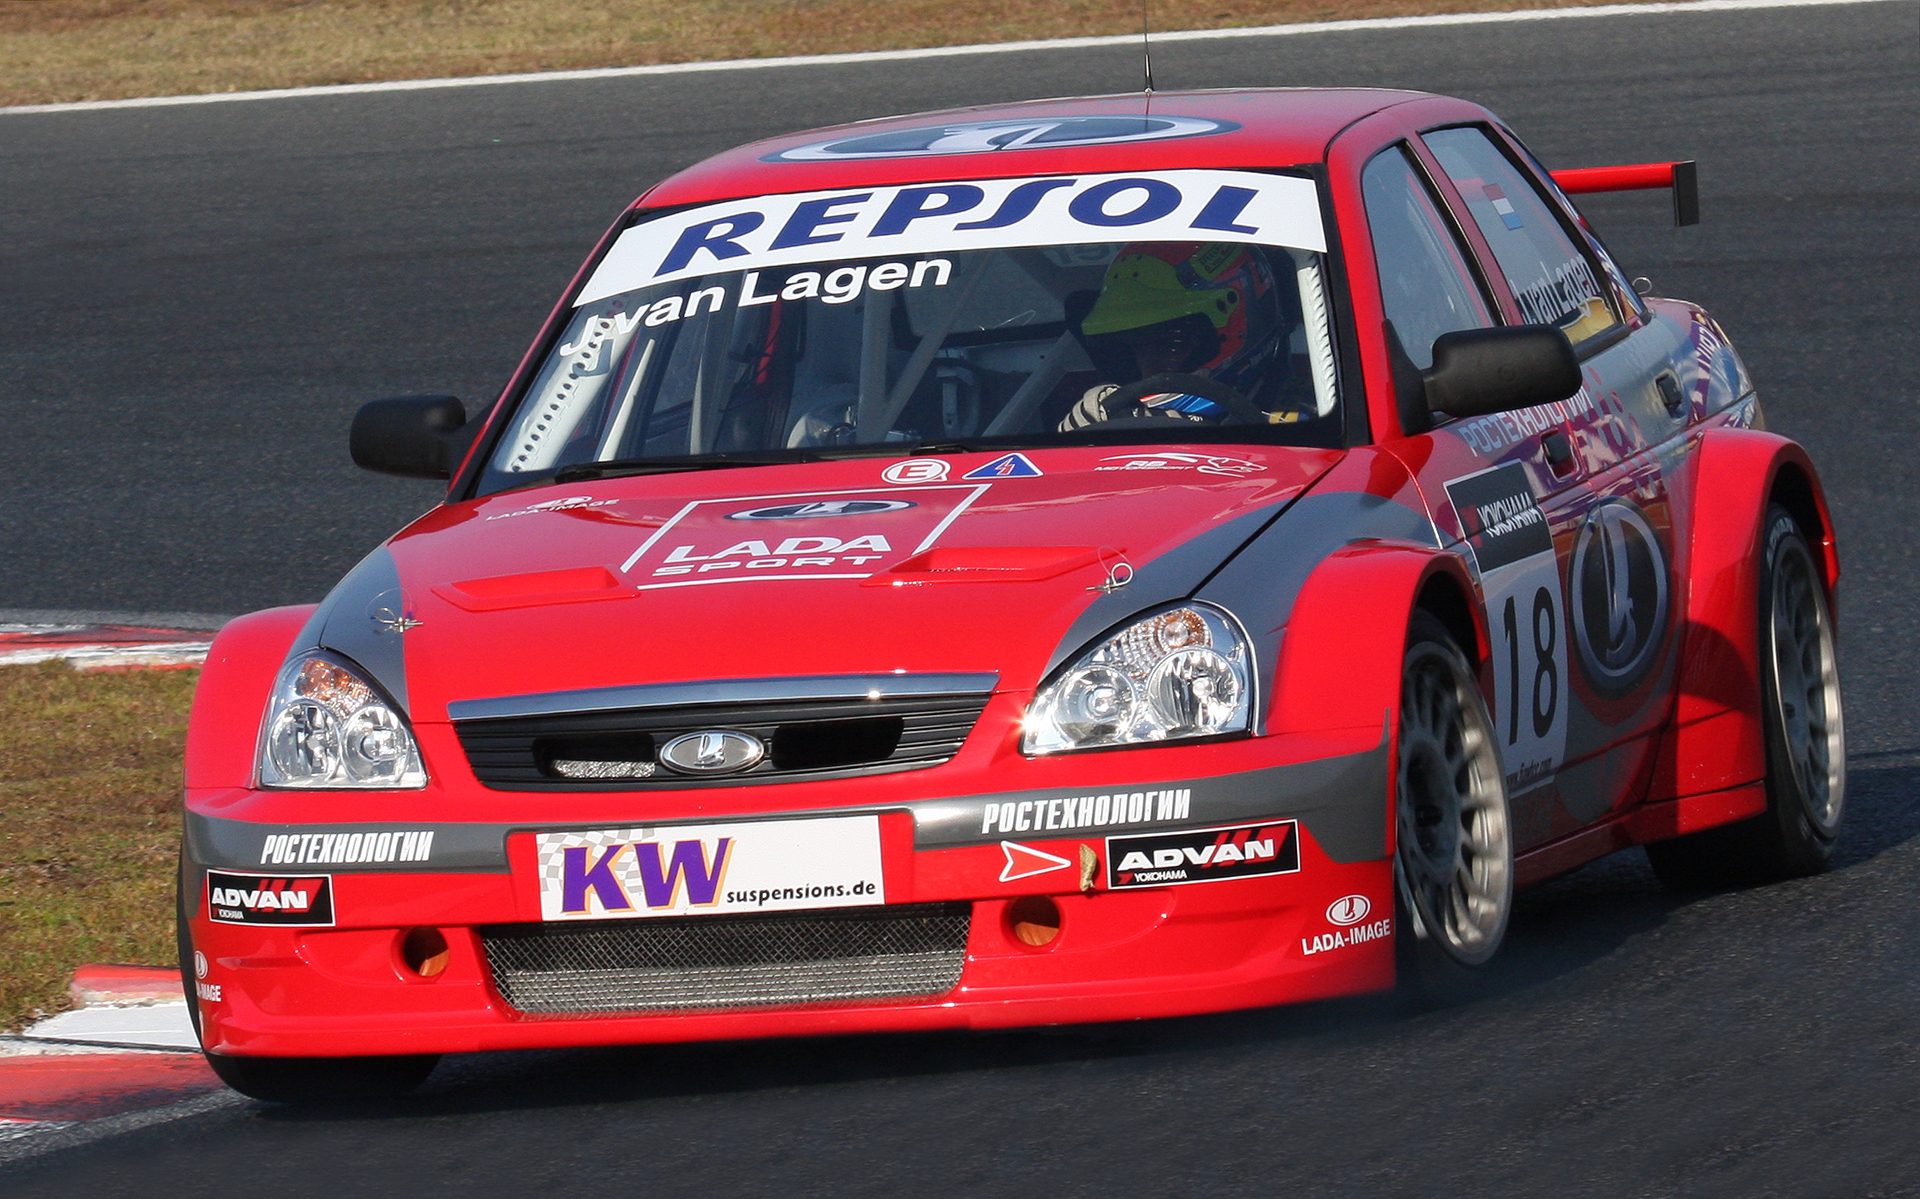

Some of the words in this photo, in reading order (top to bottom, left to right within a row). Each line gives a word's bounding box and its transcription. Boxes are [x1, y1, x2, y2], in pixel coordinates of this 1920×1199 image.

[652, 178, 1260, 278] REPSOL
[613, 284, 726, 335] van
[738, 257, 952, 307] Lagen
[1540, 253, 1600, 318] Lagen
[486, 499, 620, 521] LADA-IMAGE
[652, 555, 882, 577] SPORT
[664, 535, 892, 564] LADA
[1503, 587, 1558, 740] 18
[982, 789, 1190, 834] РОСТЕХНОЛОГИИ
[260, 831, 434, 864] РОСТЕХНОЛОГИИ
[1117, 839, 1275, 871] ADVAN
[562, 836, 737, 915] KW
[1134, 869, 1188, 883] YOKOHAMA
[211, 887, 308, 909] ADVAN
[727, 880, 876, 906] suspensions.de
[1302, 918, 1391, 955] LADA-IMAGE
